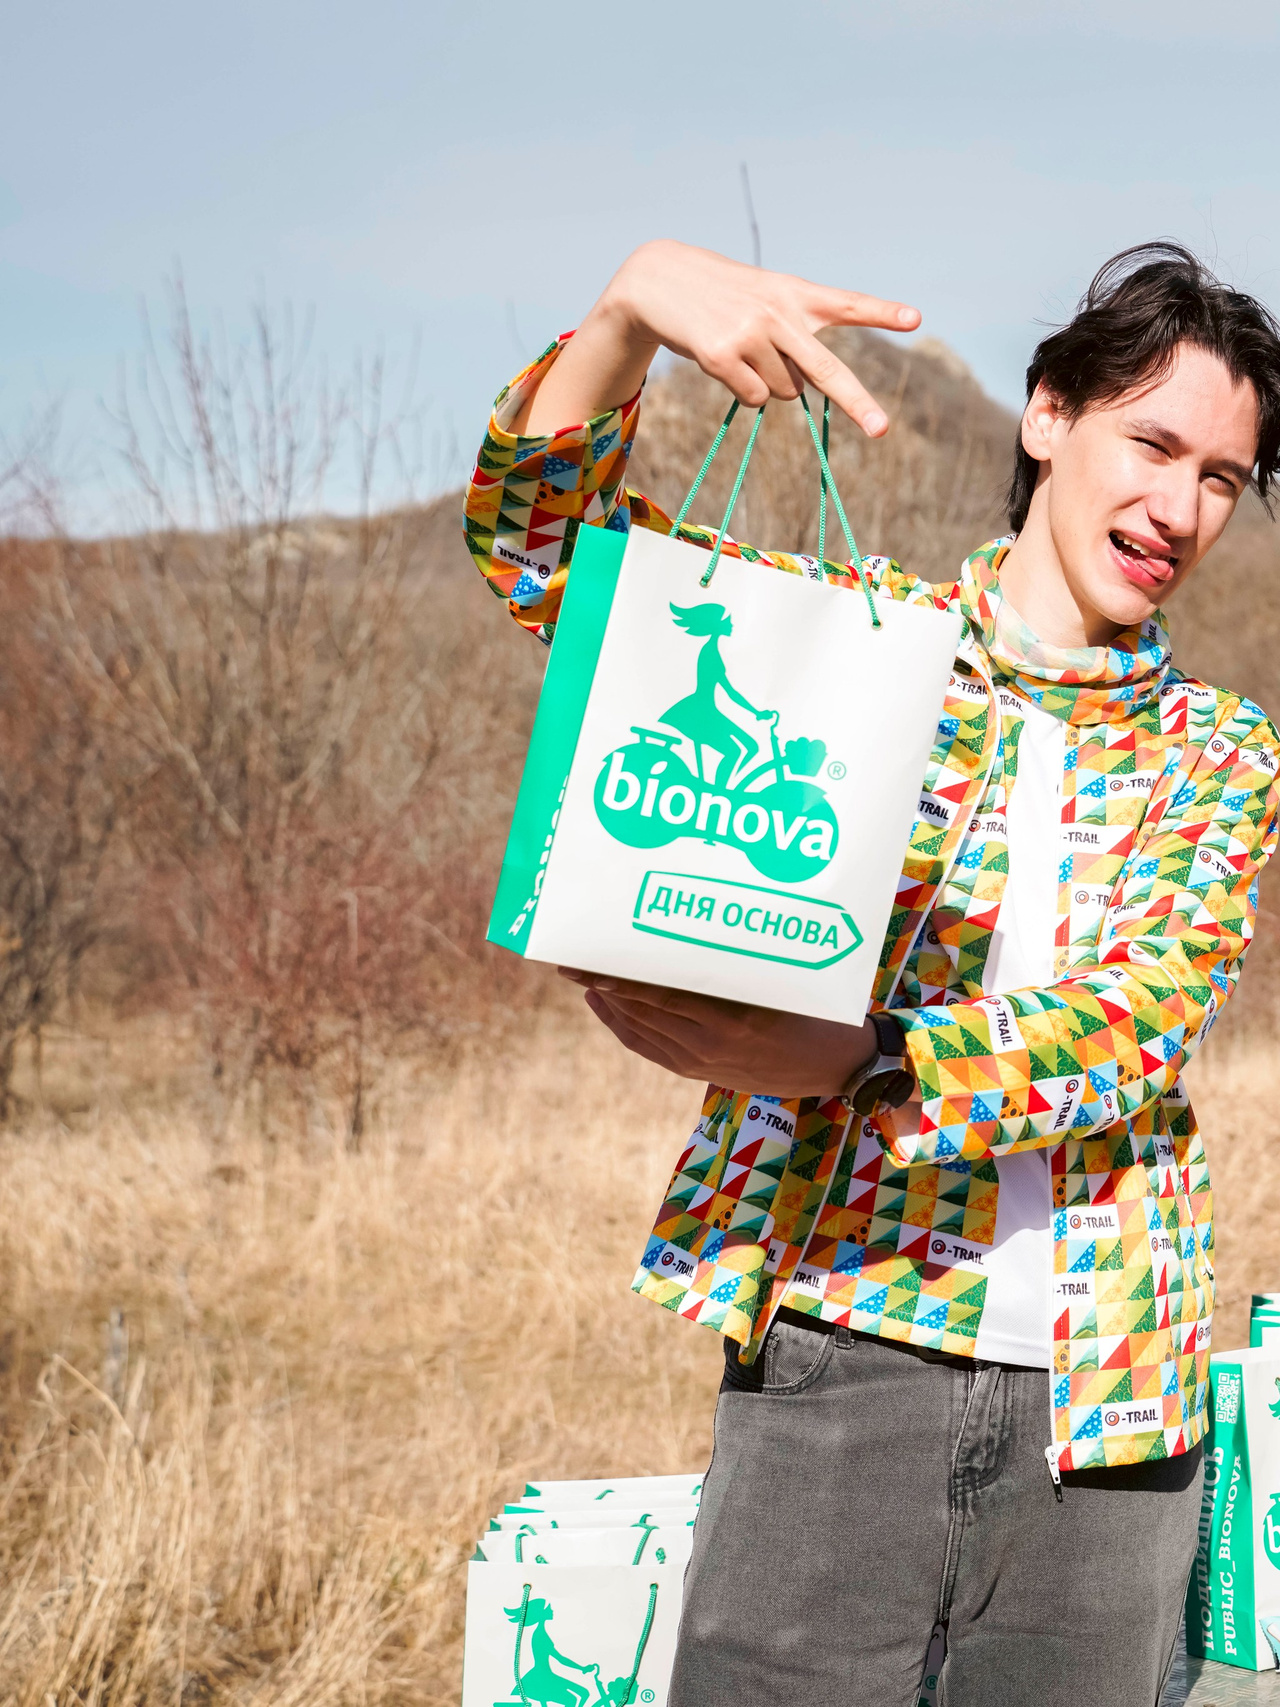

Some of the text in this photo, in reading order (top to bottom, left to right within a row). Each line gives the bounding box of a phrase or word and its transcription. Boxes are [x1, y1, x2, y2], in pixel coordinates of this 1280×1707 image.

[602, 751, 834, 861] bionova
[647, 885, 839, 949] ДНЯ ОСНОВА
[1219, 1454, 1242, 1656] PUBLIC_BIONOVA
